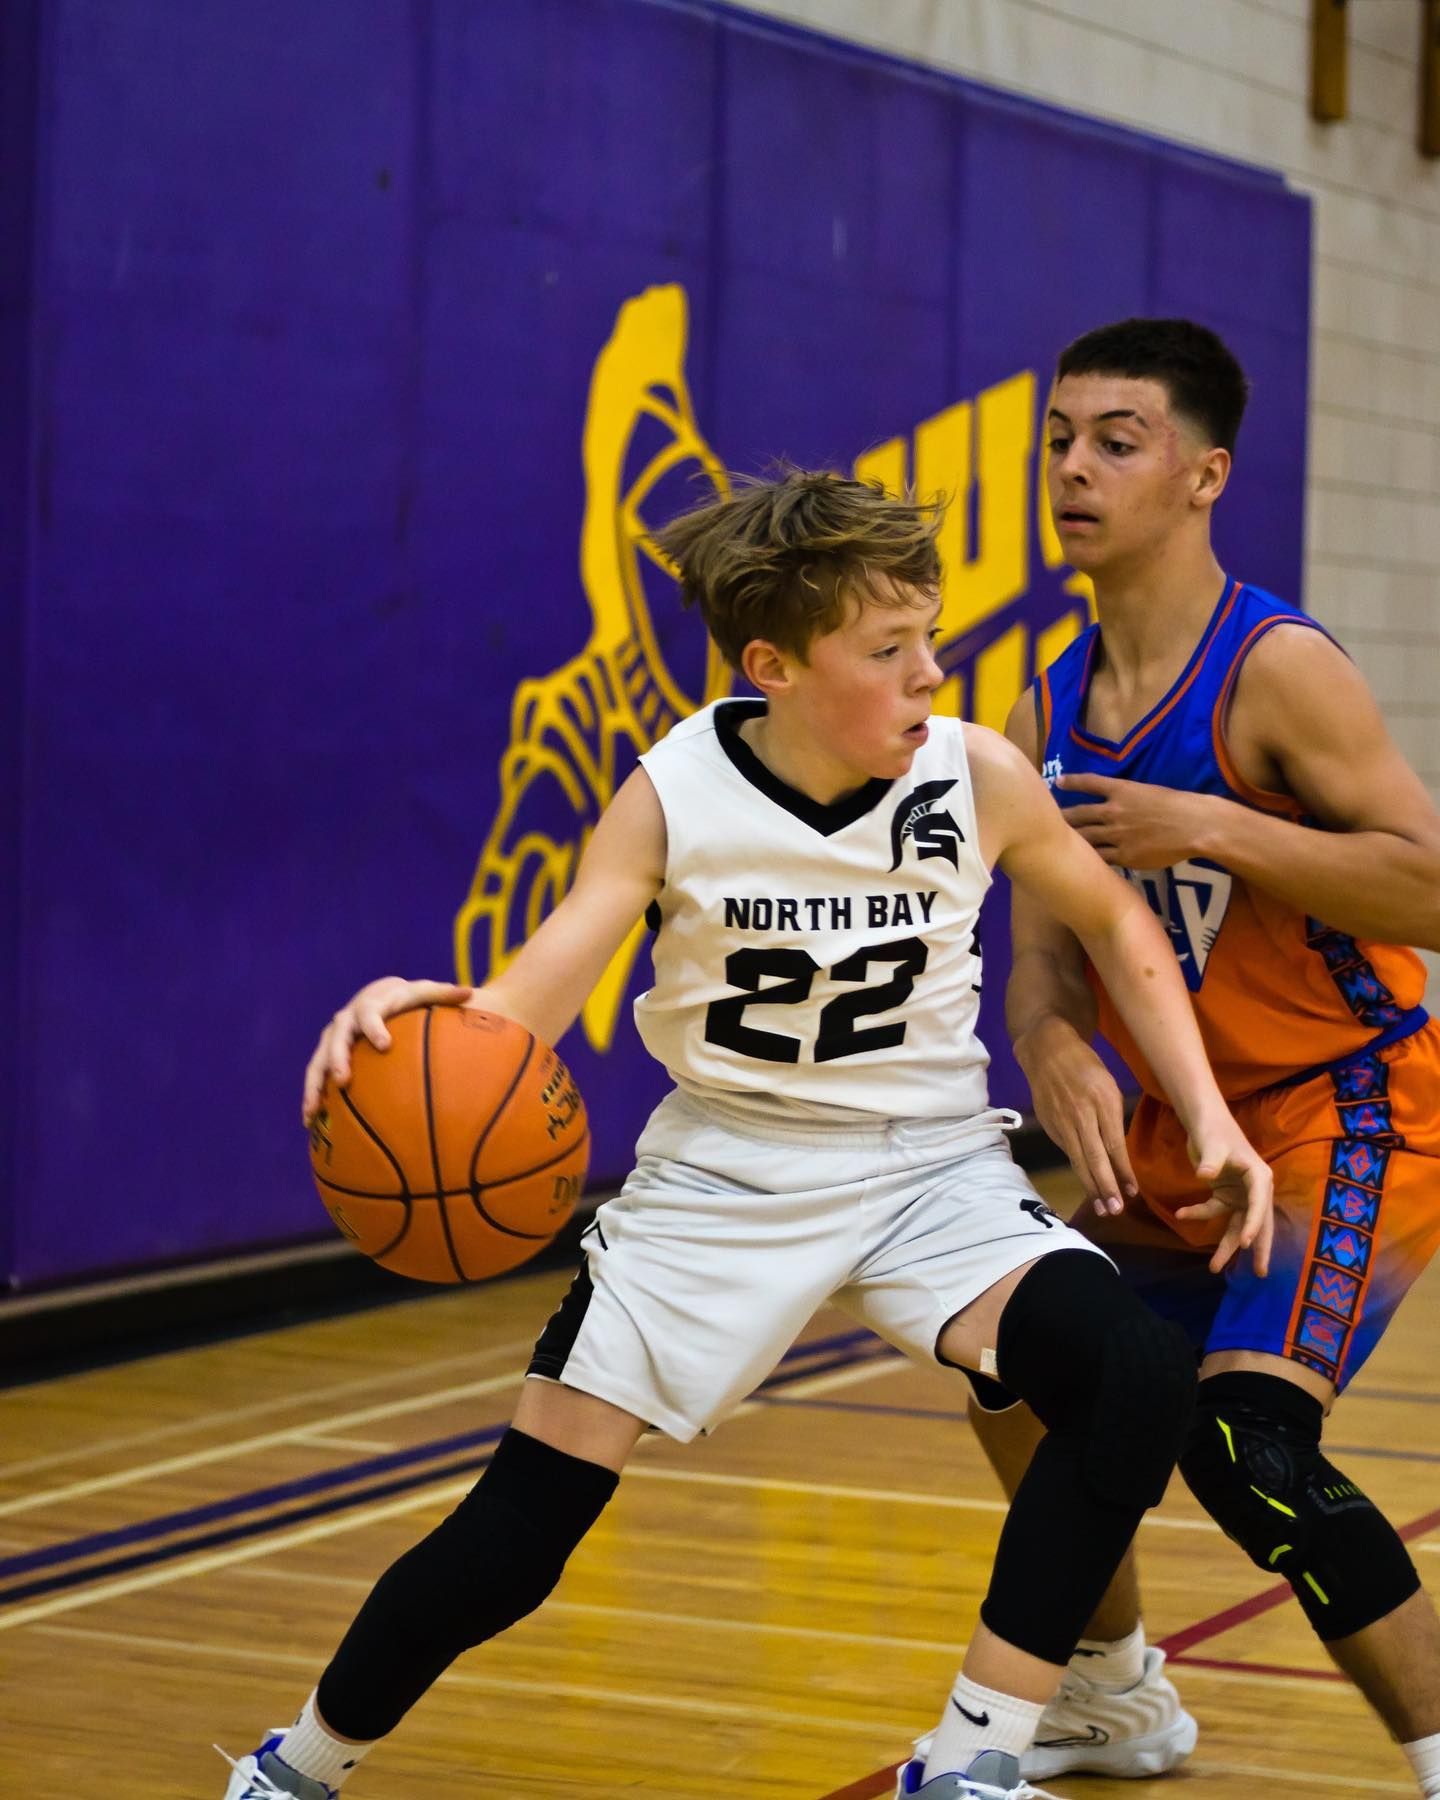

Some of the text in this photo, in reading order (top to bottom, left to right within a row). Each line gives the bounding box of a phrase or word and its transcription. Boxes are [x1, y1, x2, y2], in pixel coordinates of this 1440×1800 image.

[723, 891, 939, 931] NORTH BAY
[704, 936, 929, 1064] 22
